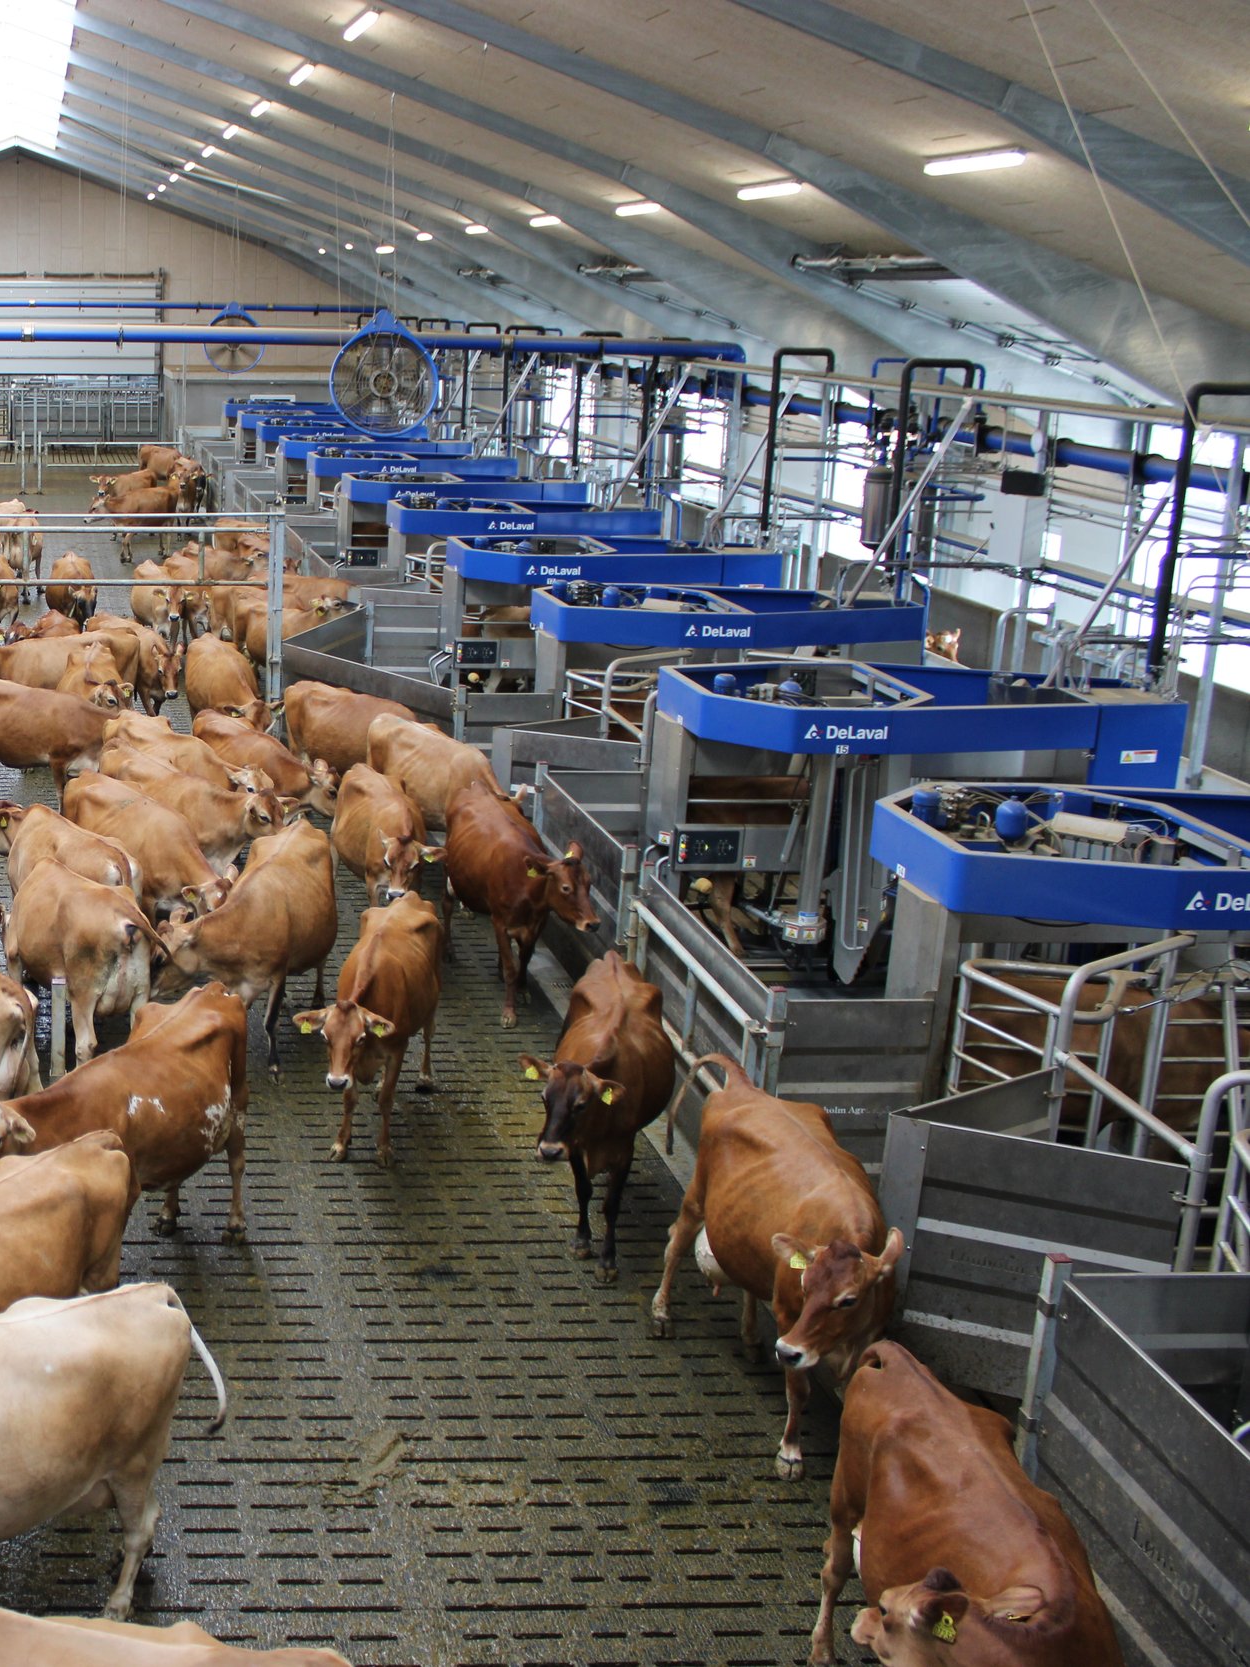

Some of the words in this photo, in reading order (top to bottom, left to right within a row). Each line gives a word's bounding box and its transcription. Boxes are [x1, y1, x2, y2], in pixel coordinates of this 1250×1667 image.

[500, 522, 535, 530] DeLaval
[540, 566, 581, 576] DeLaval
[702, 626, 751, 638] DeLaval
[826, 726, 889, 740] DeLaval
